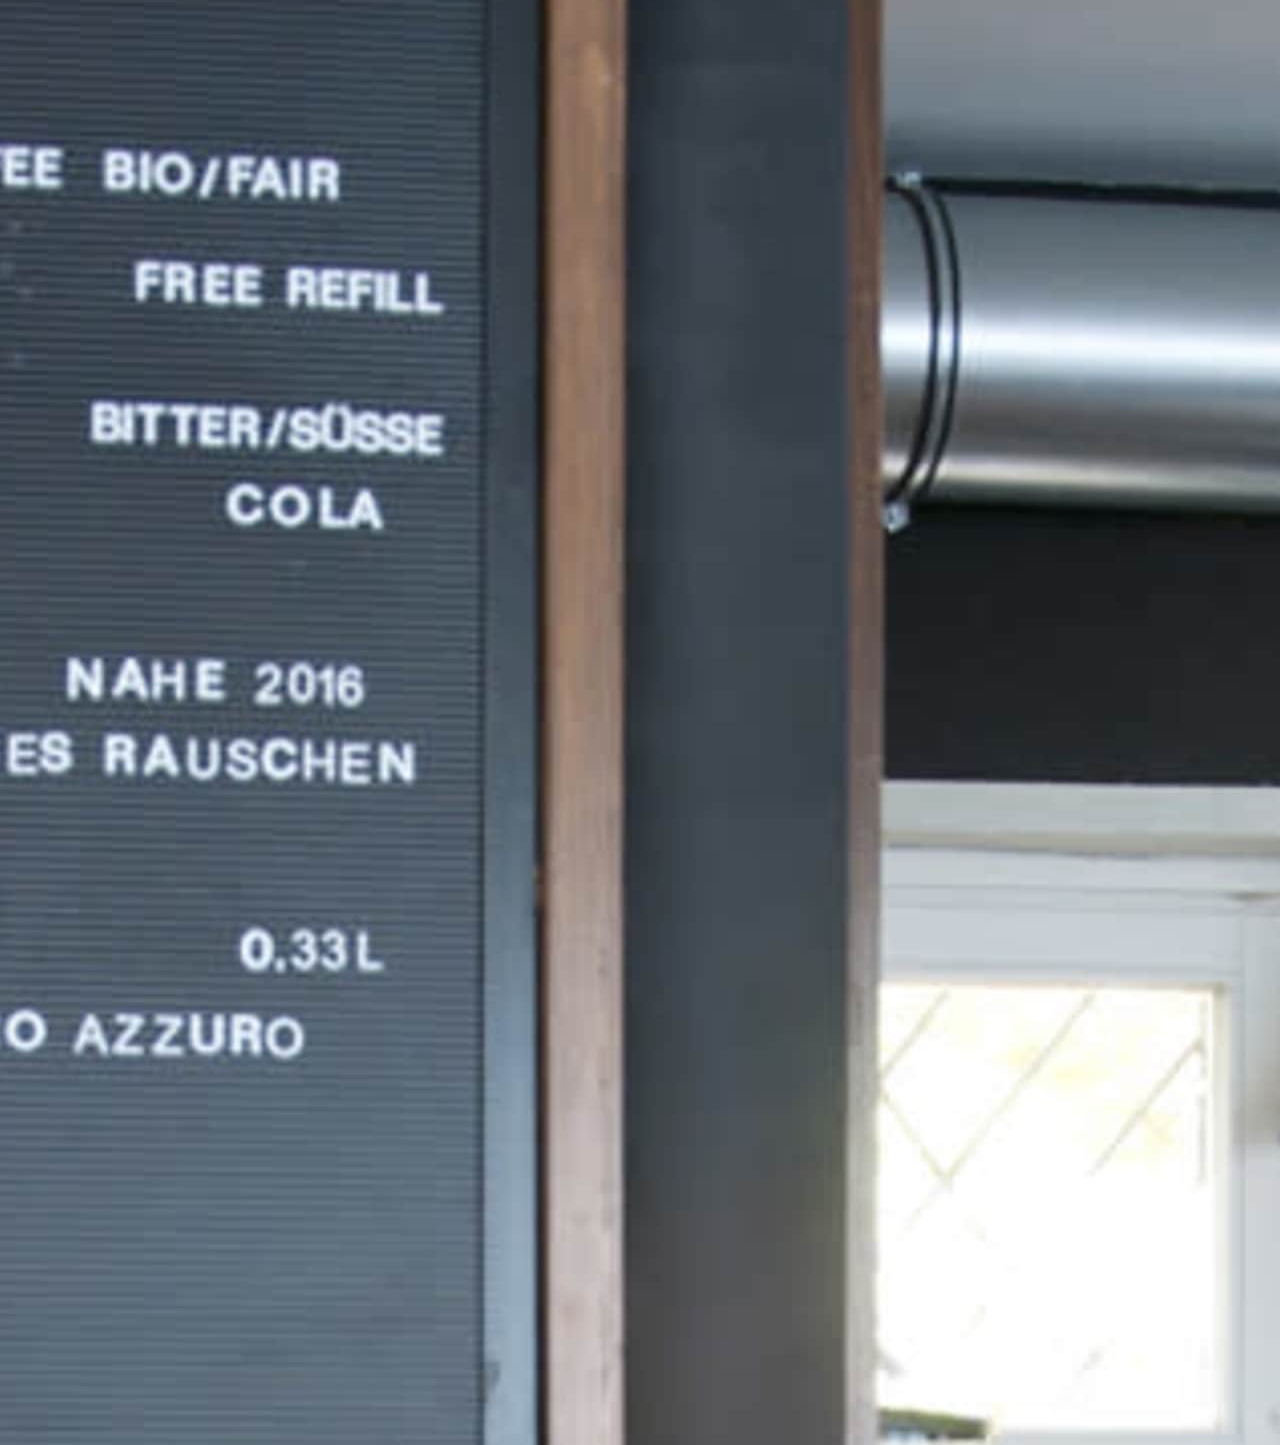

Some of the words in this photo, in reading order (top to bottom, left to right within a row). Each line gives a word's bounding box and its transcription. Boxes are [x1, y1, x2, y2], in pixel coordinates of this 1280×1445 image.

[102, 149, 341, 201] BIO/FAIR
[134, 259, 263, 307] FREE
[285, 266, 445, 315] REFILL
[90, 400, 444, 457] BITTER/SÜSSE
[225, 482, 384, 531] COLA
[66, 656, 226, 702] NAHE
[254, 661, 366, 708] 2016
[103, 732, 416, 786] RAUSCHEN
[72, 1012, 305, 1060] AZZURO
